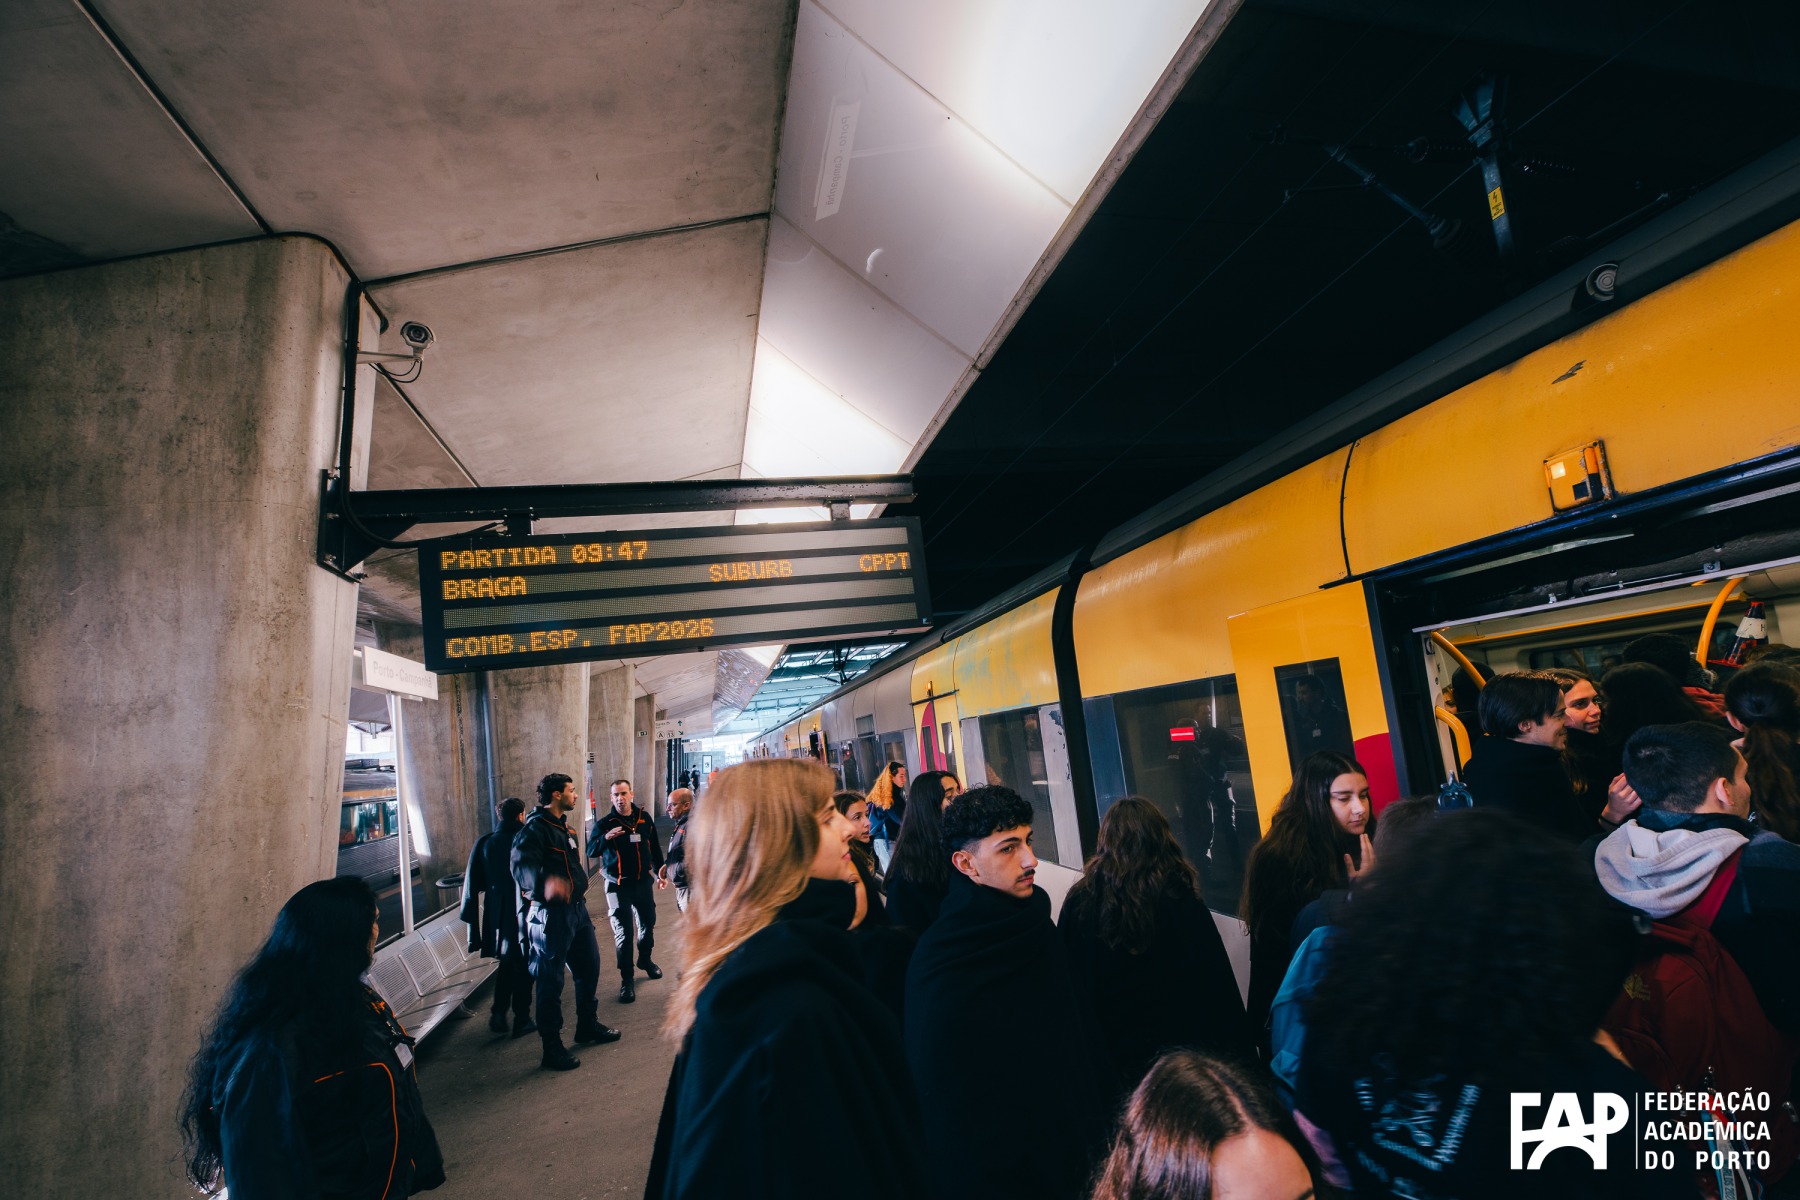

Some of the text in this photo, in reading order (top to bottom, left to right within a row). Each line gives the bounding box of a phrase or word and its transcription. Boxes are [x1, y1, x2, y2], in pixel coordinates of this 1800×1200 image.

[441, 540, 648, 569] PARTIDA 09:47
[442, 552, 909, 600] BRAGA SUBURB CPPT
[609, 618, 715, 645] FAP2026
[373, 661, 394, 678] Porto
